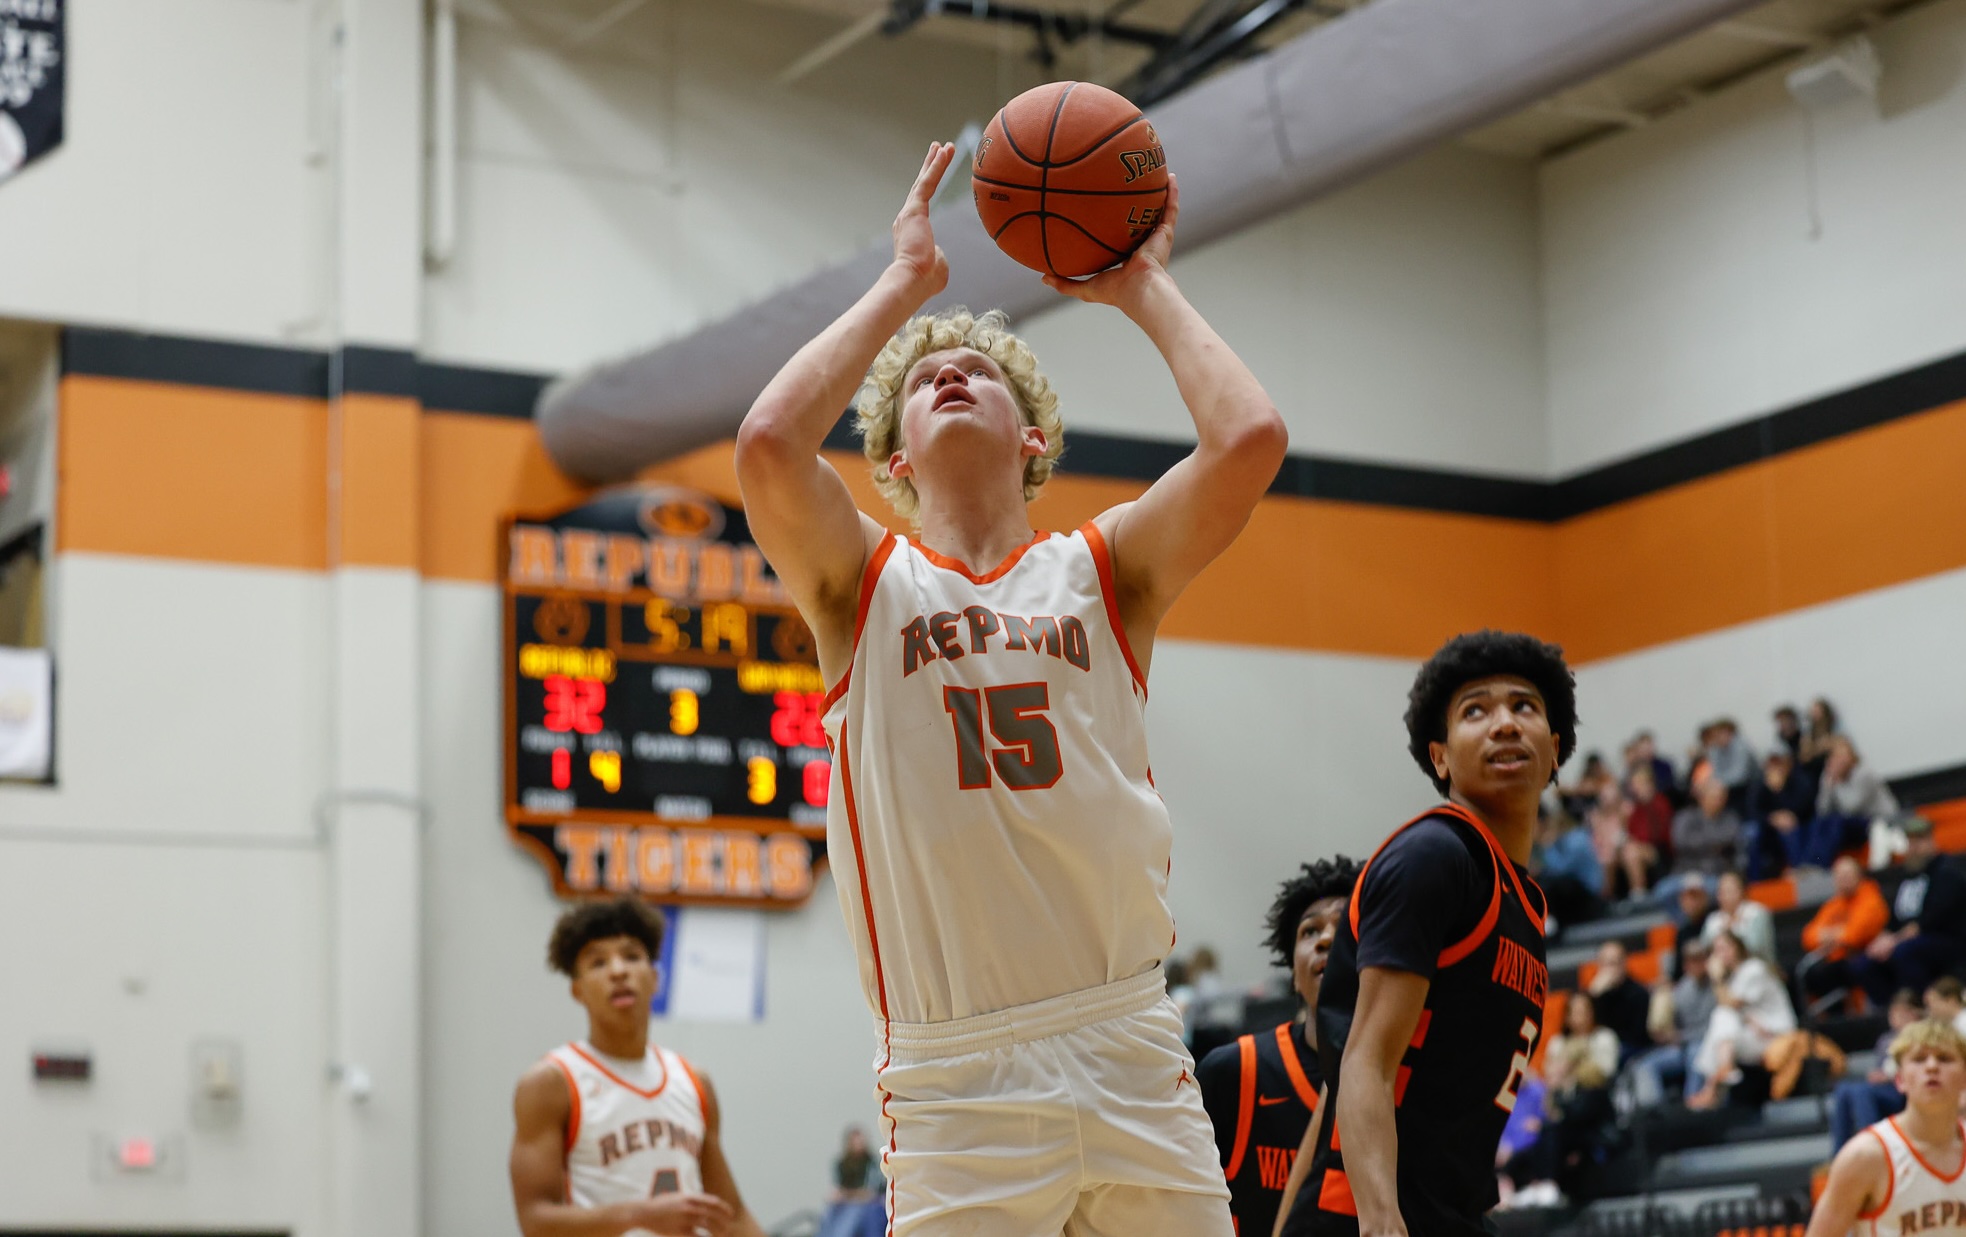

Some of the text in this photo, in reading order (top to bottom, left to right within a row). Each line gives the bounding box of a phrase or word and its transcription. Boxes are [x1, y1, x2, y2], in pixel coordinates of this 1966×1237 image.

[511, 528, 794, 605] REPUBL
[901, 605, 1090, 678] REPMO
[543, 674, 606, 735] 32
[669, 688, 699, 737] 3
[943, 681, 1064, 791] 15
[552, 747, 571, 790] 1
[747, 756, 777, 806] 3
[555, 826, 812, 897] TIGERS
[1494, 1015, 1540, 1114] 2
